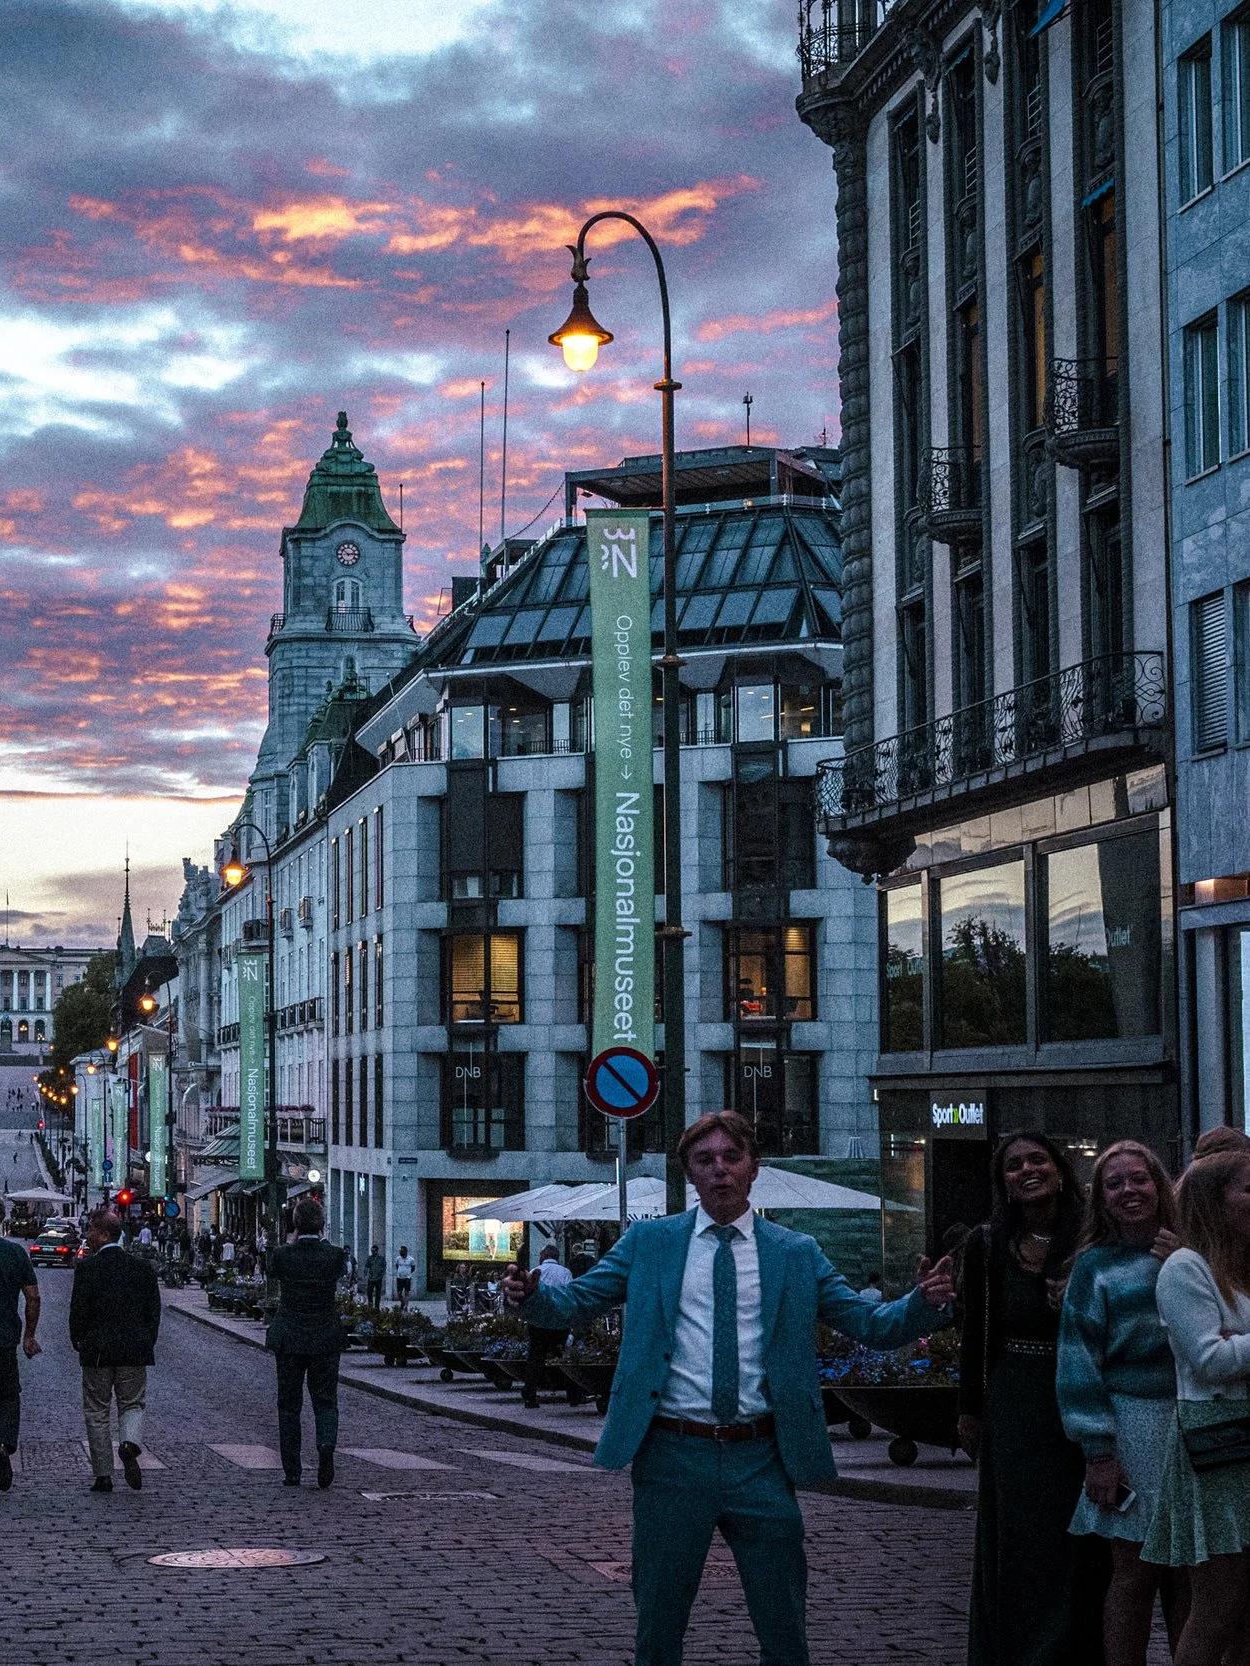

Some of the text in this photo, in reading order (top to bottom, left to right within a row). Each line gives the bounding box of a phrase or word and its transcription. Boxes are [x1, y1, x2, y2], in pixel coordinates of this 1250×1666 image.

[610, 614, 640, 1042] Opplev det nye Nasjonalmuseet
[455, 1066, 481, 1078] DNB
[744, 1065, 772, 1078] DNB
[247, 1067, 259, 1170] Nasjonalmuseet
[932, 1103, 984, 1128] Sport Outlet
